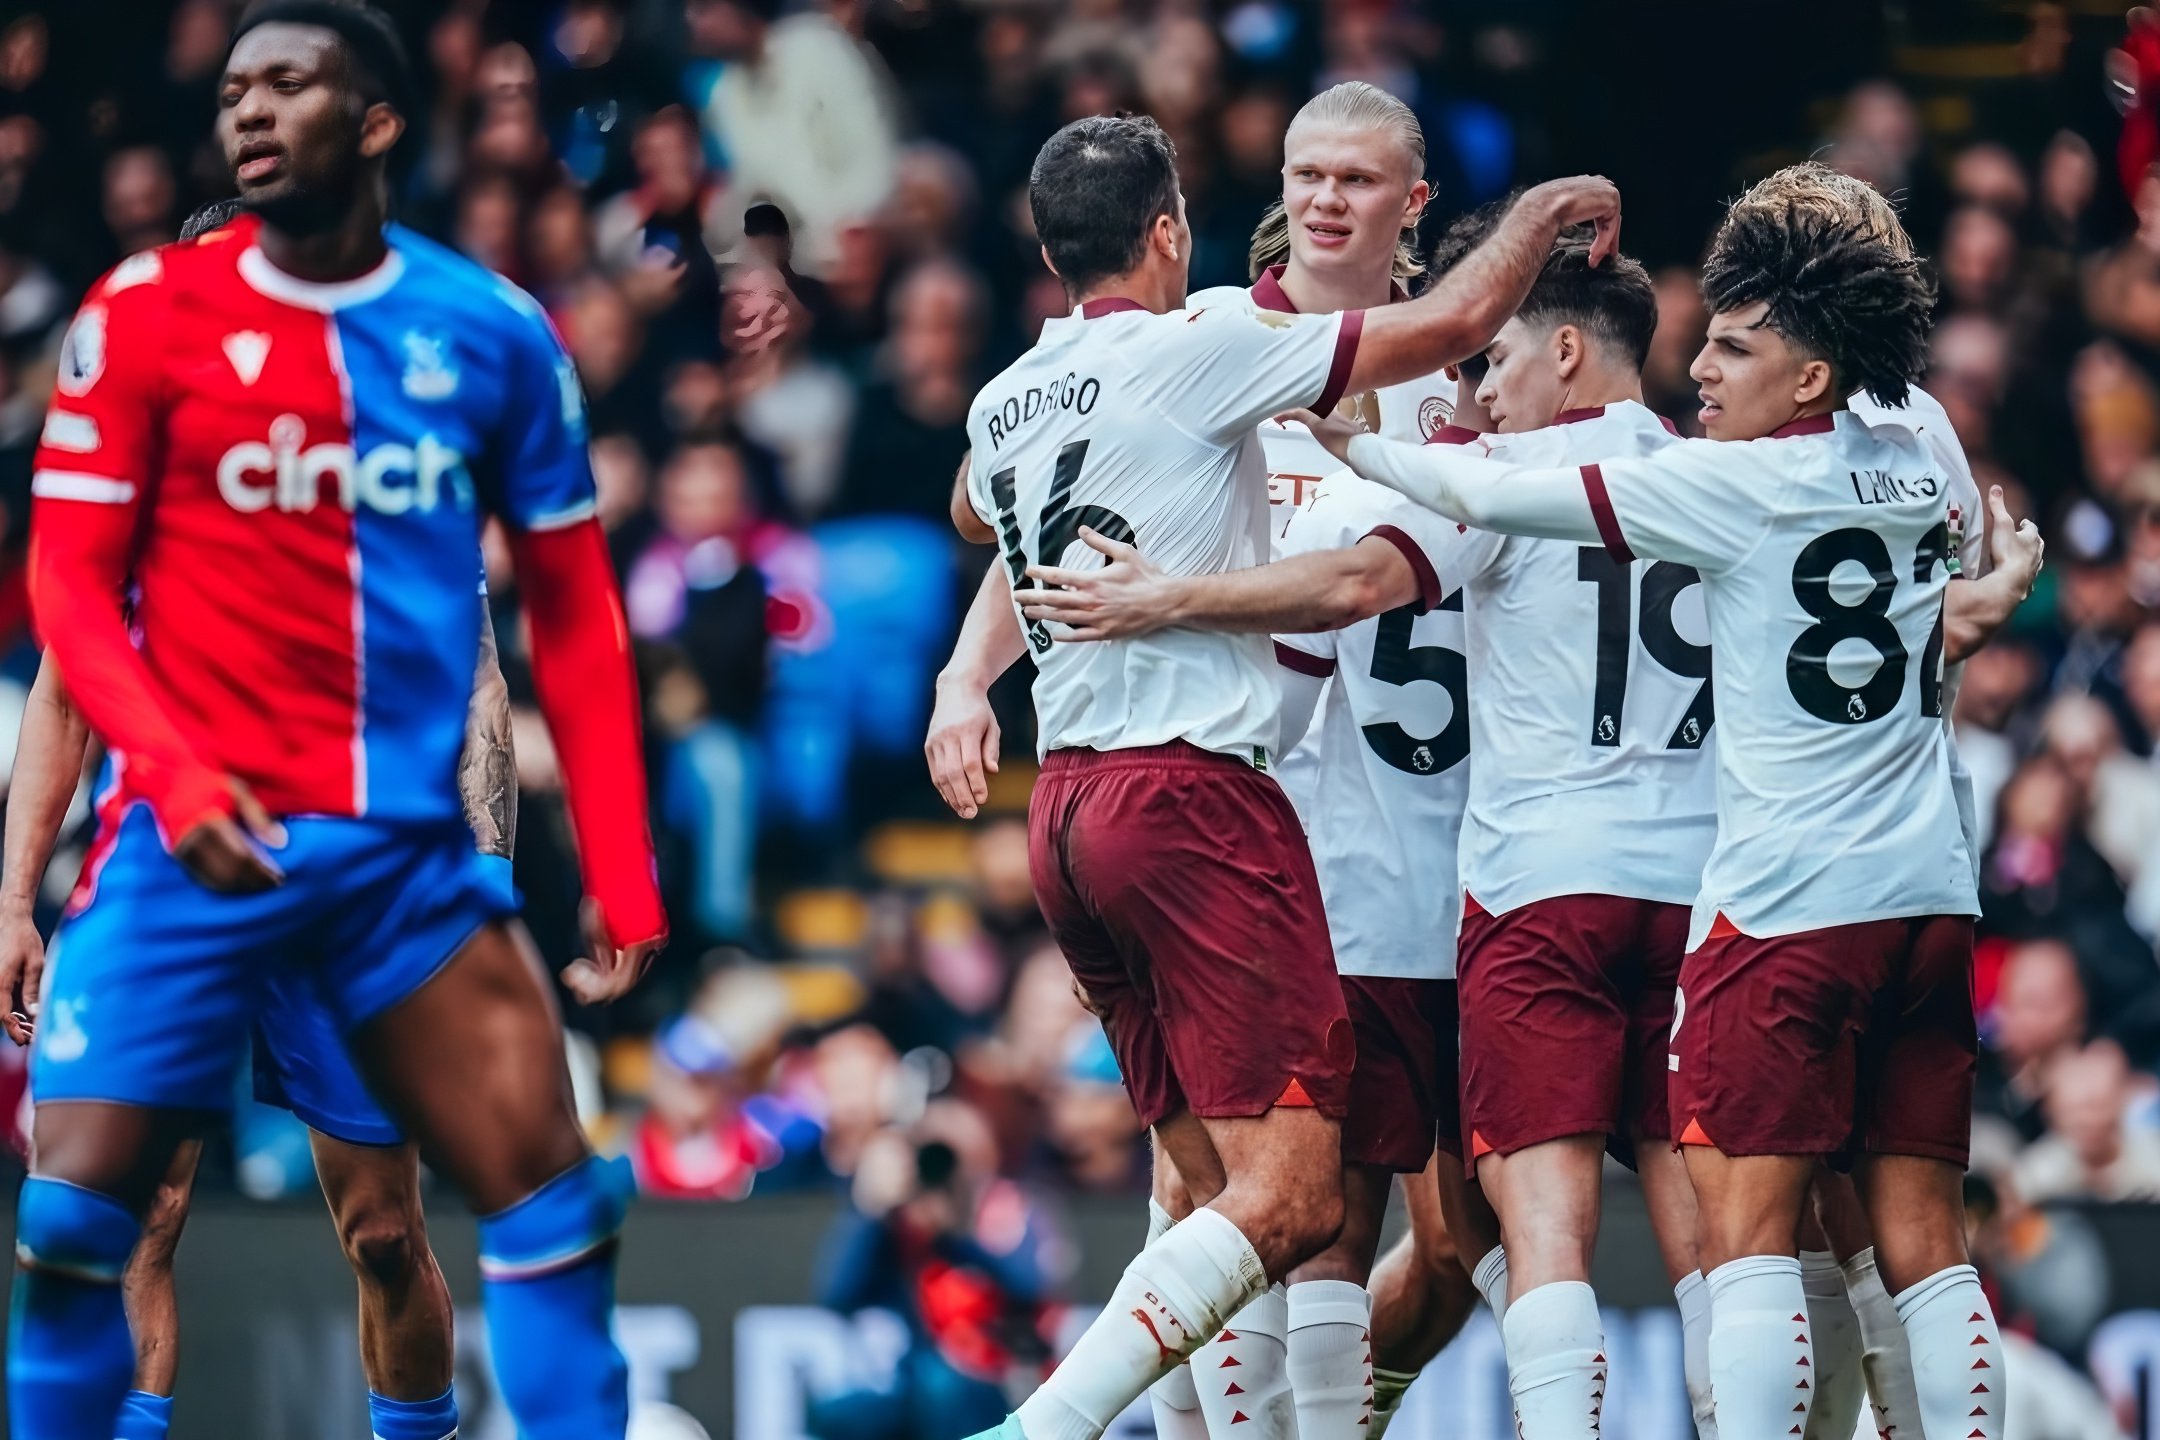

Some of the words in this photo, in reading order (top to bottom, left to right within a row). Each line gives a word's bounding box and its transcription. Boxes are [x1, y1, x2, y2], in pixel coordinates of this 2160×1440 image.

[216, 412, 477, 516] cinch
[988, 371, 1101, 450] RODRIGO
[990, 438, 1138, 655] 16
[1361, 586, 1470, 776] 5
[1578, 546, 1715, 750] 19
